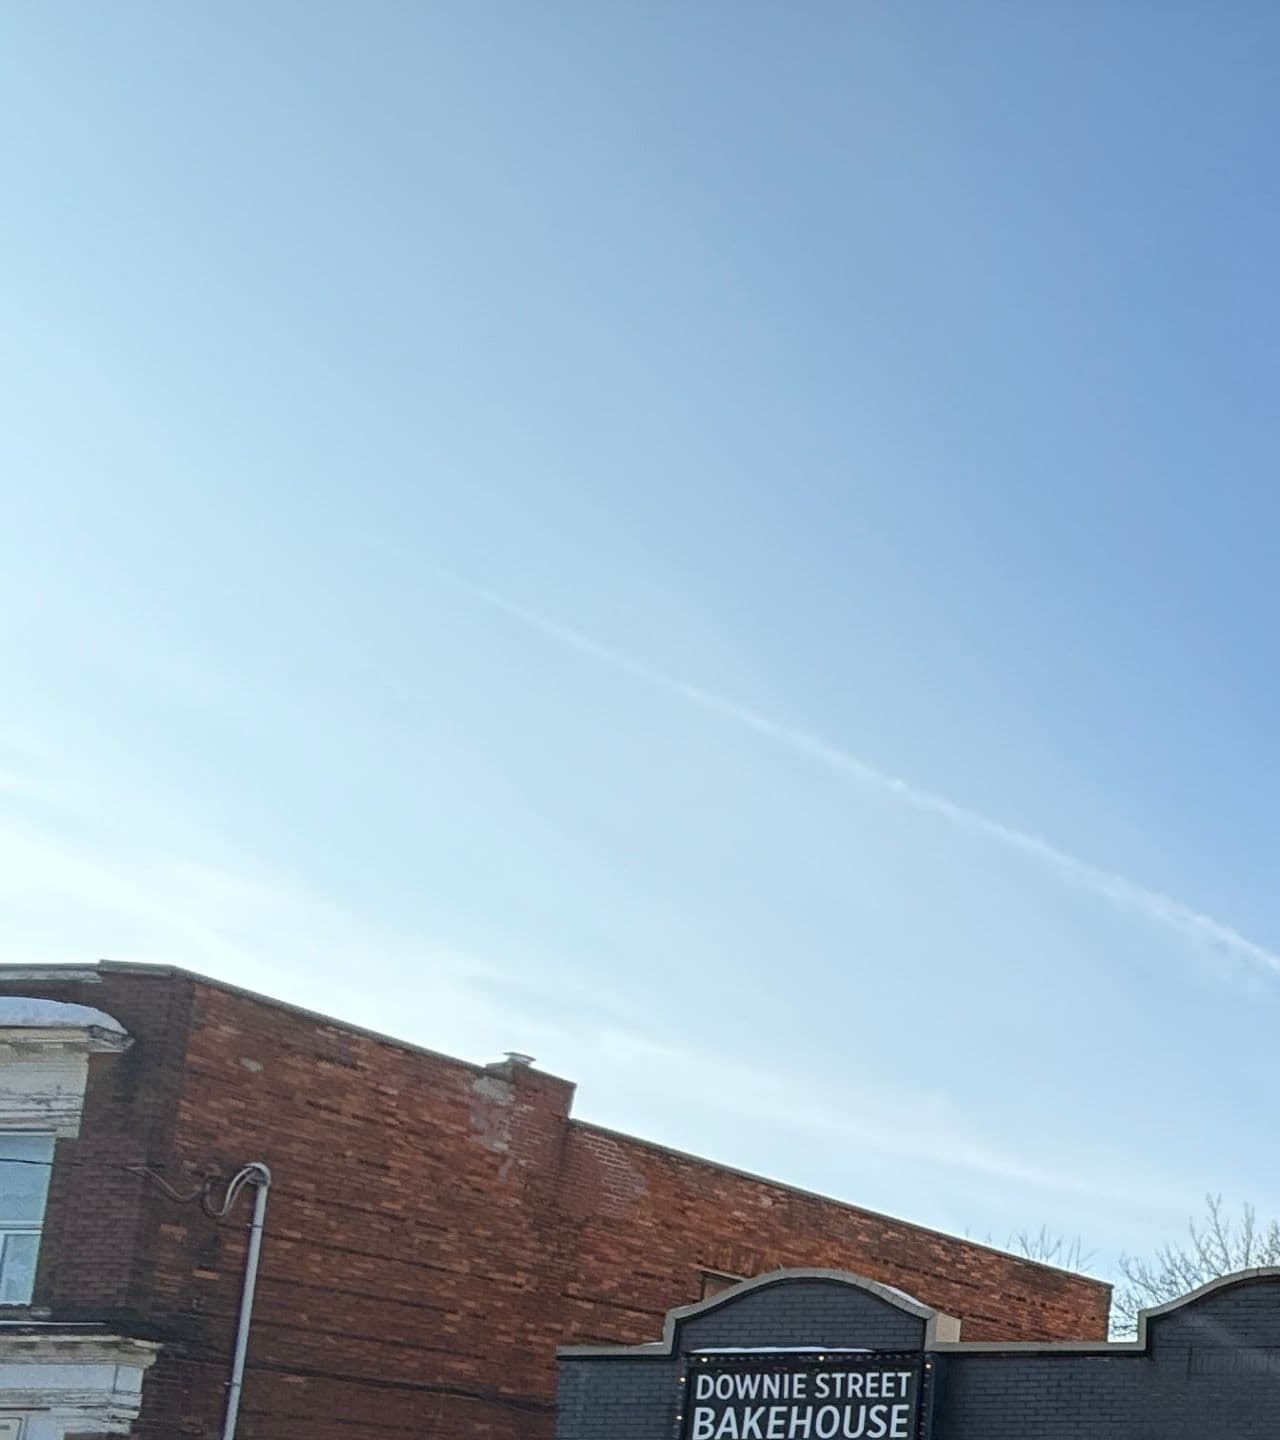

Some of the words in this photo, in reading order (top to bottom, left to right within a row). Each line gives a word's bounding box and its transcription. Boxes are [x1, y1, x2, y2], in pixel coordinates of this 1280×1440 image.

[695, 1374, 807, 1400] DOWNIE
[815, 1372, 912, 1398] STREET
[692, 1405, 910, 1440] BAKEHOUSE
